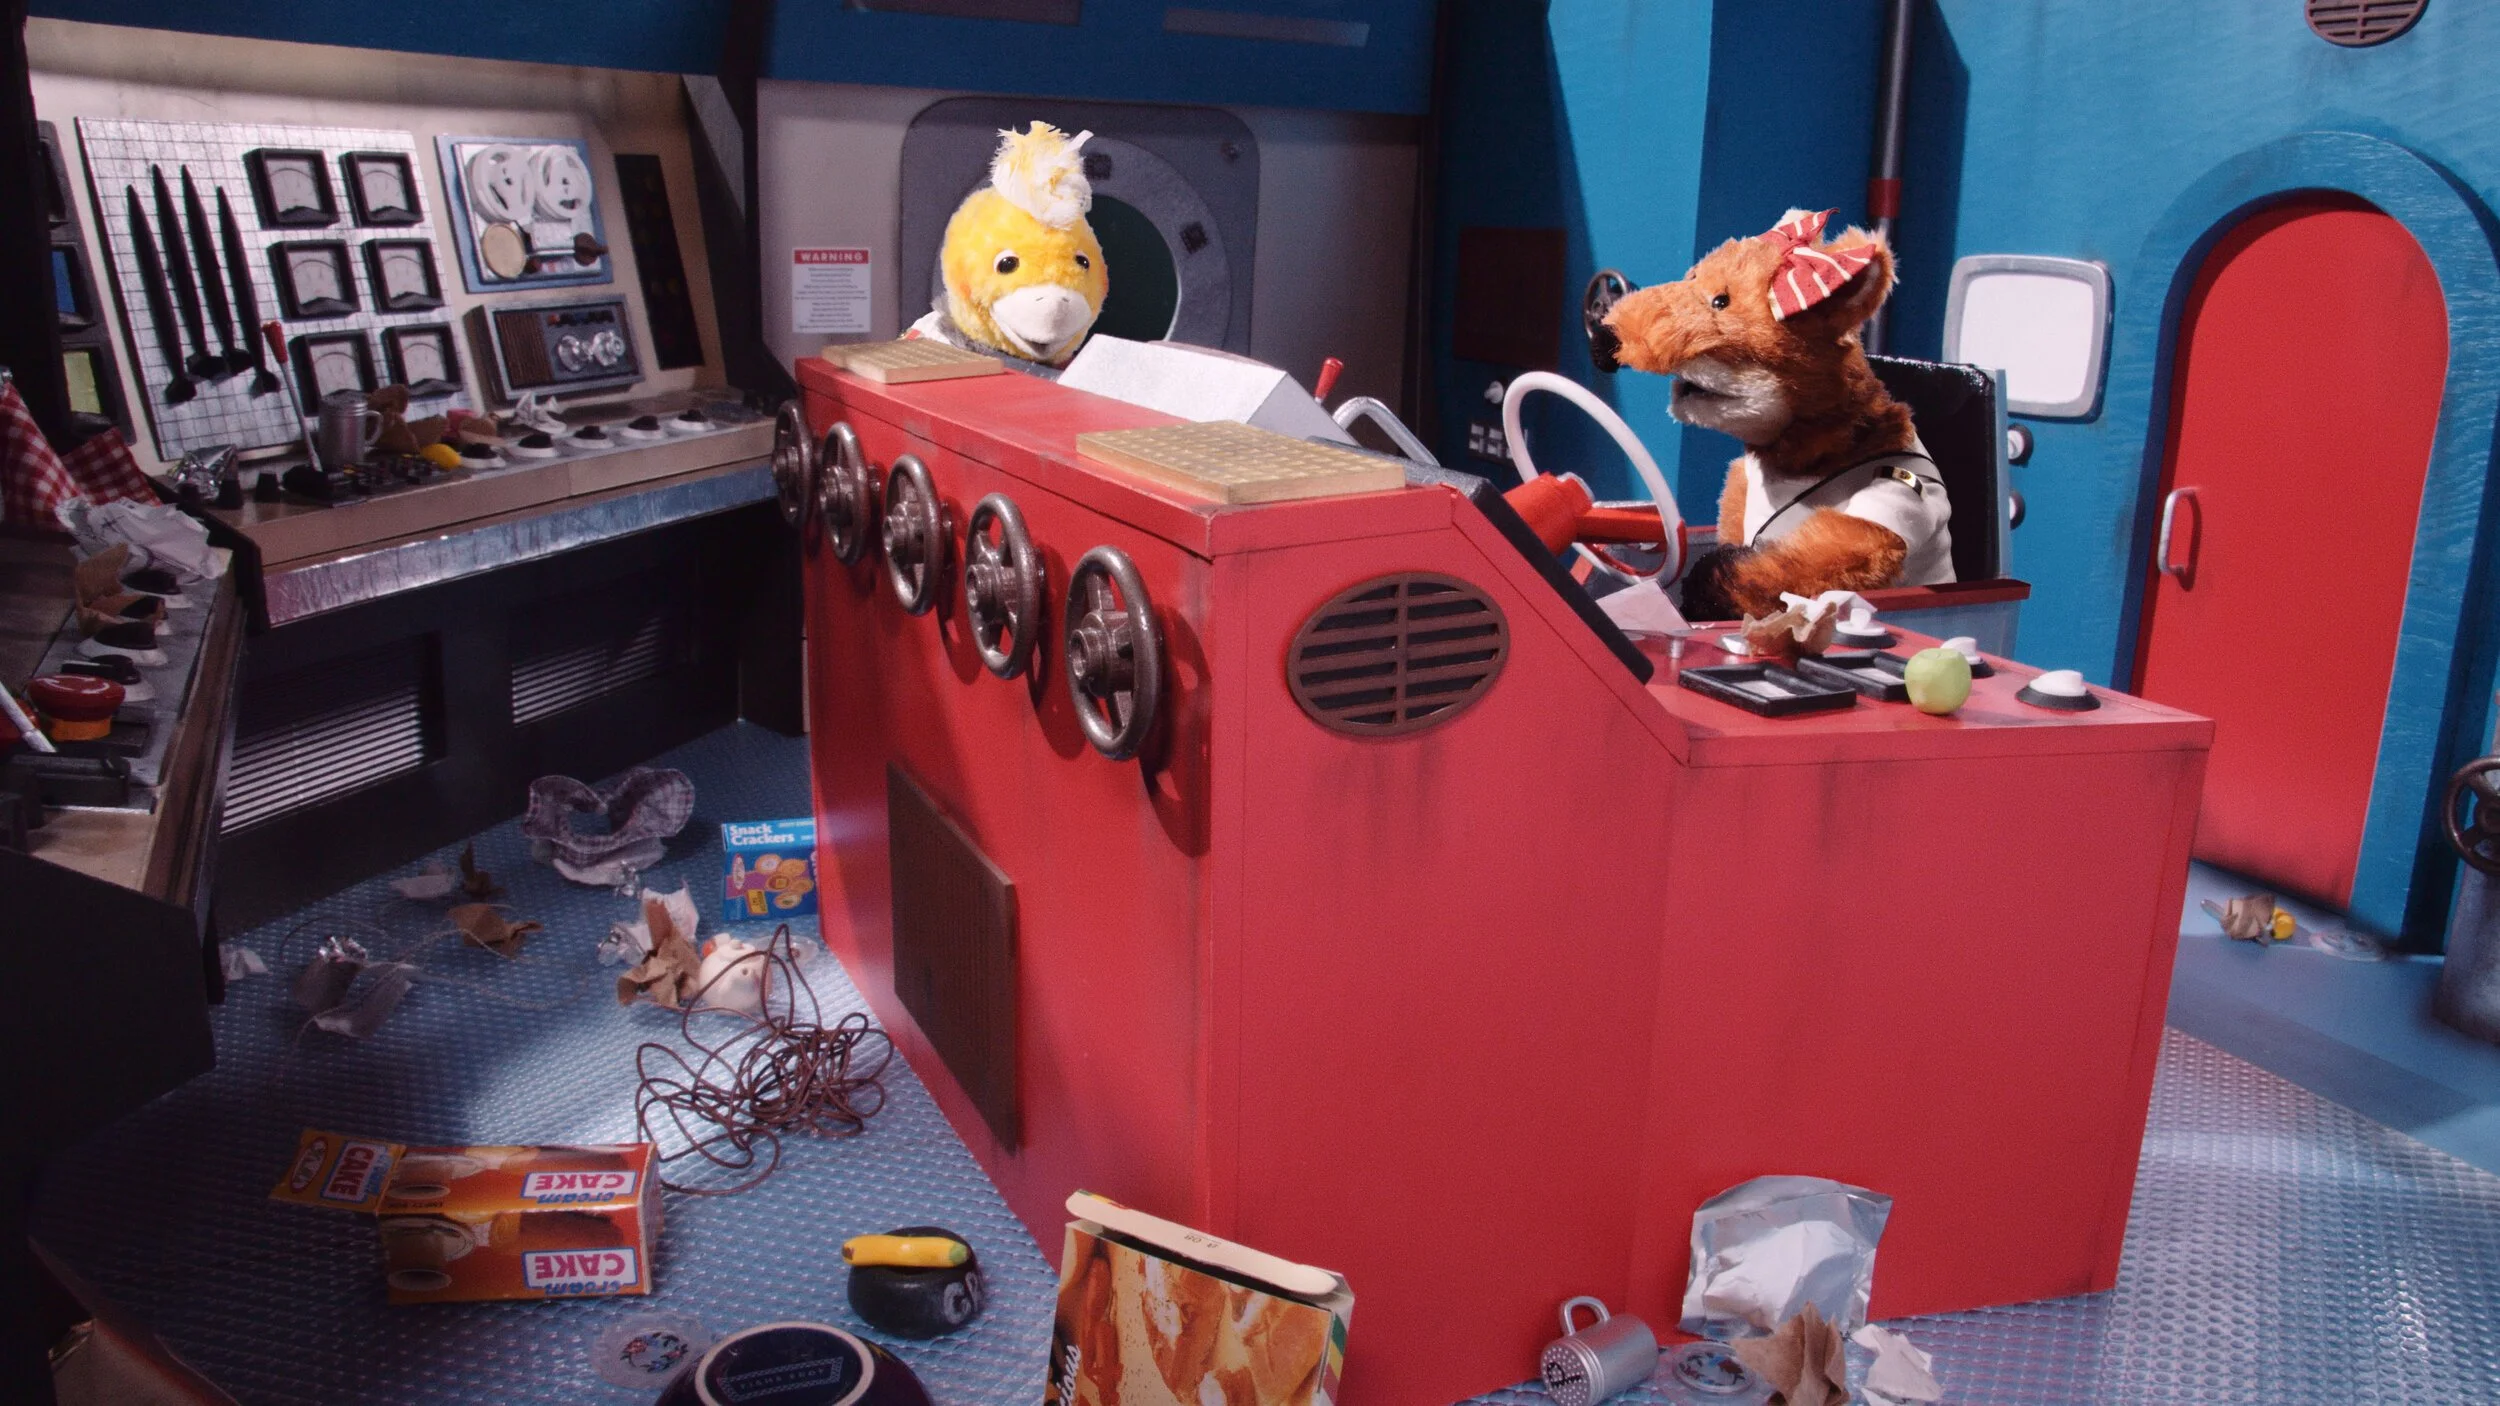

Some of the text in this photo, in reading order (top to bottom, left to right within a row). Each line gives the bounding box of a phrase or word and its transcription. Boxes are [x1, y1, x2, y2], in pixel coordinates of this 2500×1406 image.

[801, 251, 863, 262] WARNING
[729, 823, 773, 836] Snack
[731, 833, 795, 846] Crackers
[328, 1146, 375, 1196] CAKE
[534, 1174, 626, 1191] CAKE
[536, 1191, 616, 1204] cream
[534, 1253, 626, 1280] CAKE
[544, 1280, 621, 1295] cream
